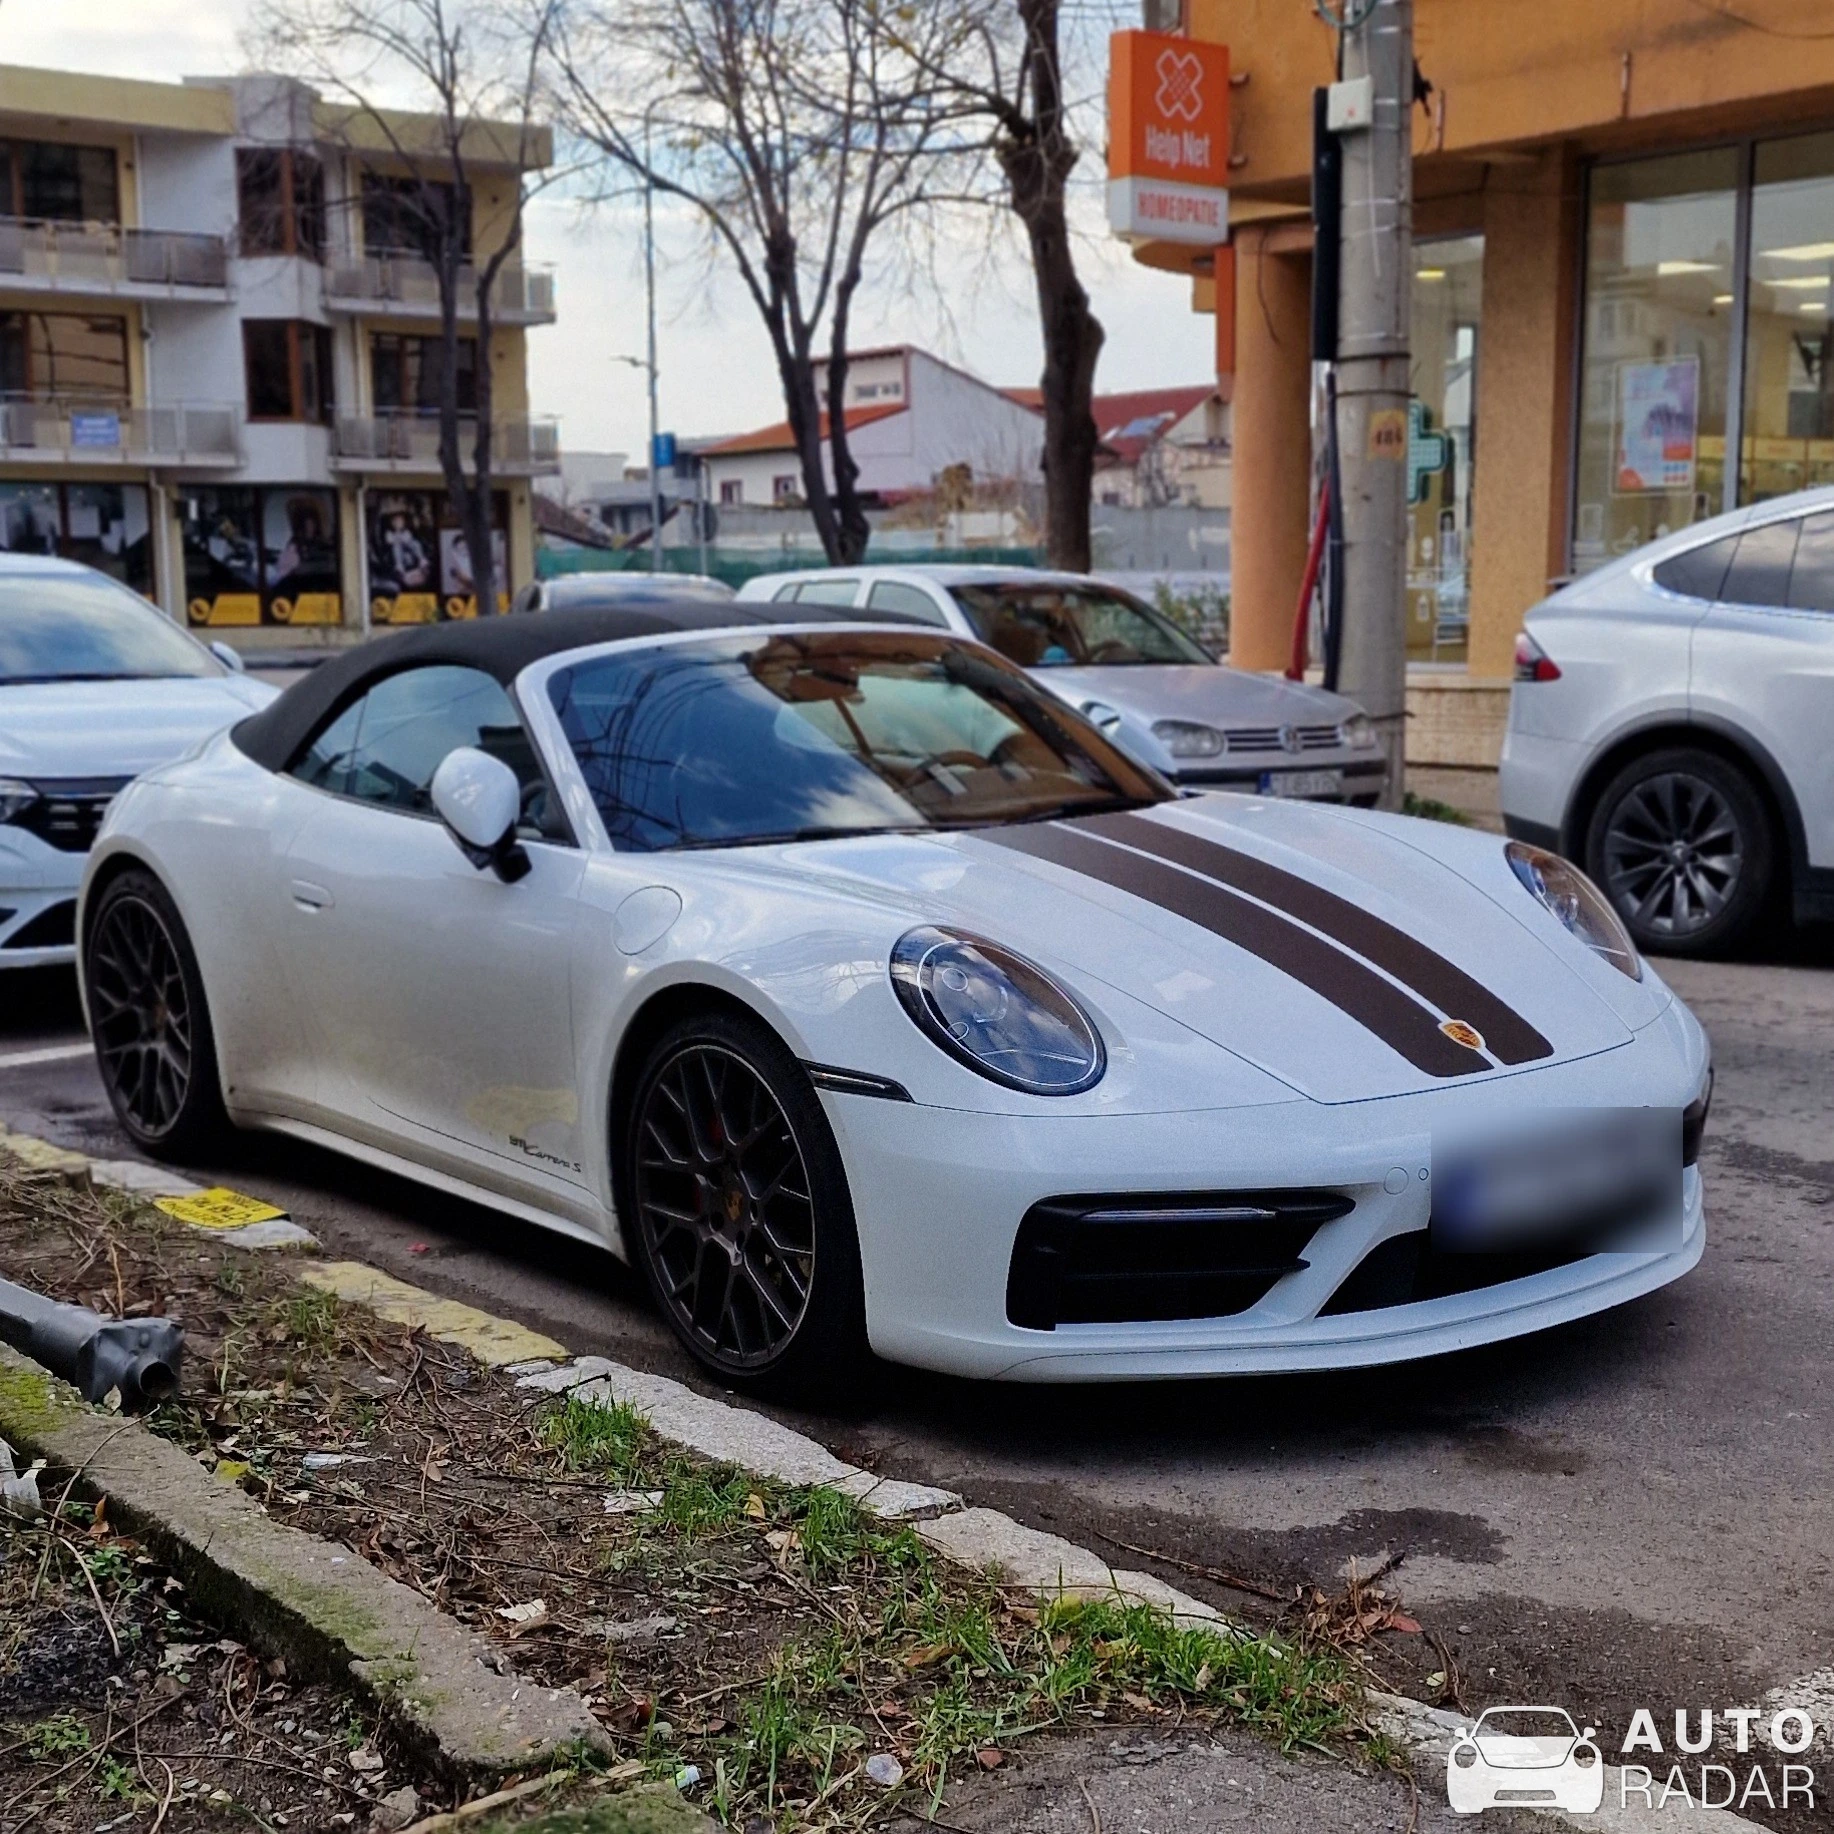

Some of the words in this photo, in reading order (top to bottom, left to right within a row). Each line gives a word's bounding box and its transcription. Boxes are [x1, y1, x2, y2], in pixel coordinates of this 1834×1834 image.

[1145, 124, 1181, 169] Help
[1182, 131, 1210, 168] Net
[523, 1145, 570, 1168] Carrera
[572, 1162, 582, 1173] S
